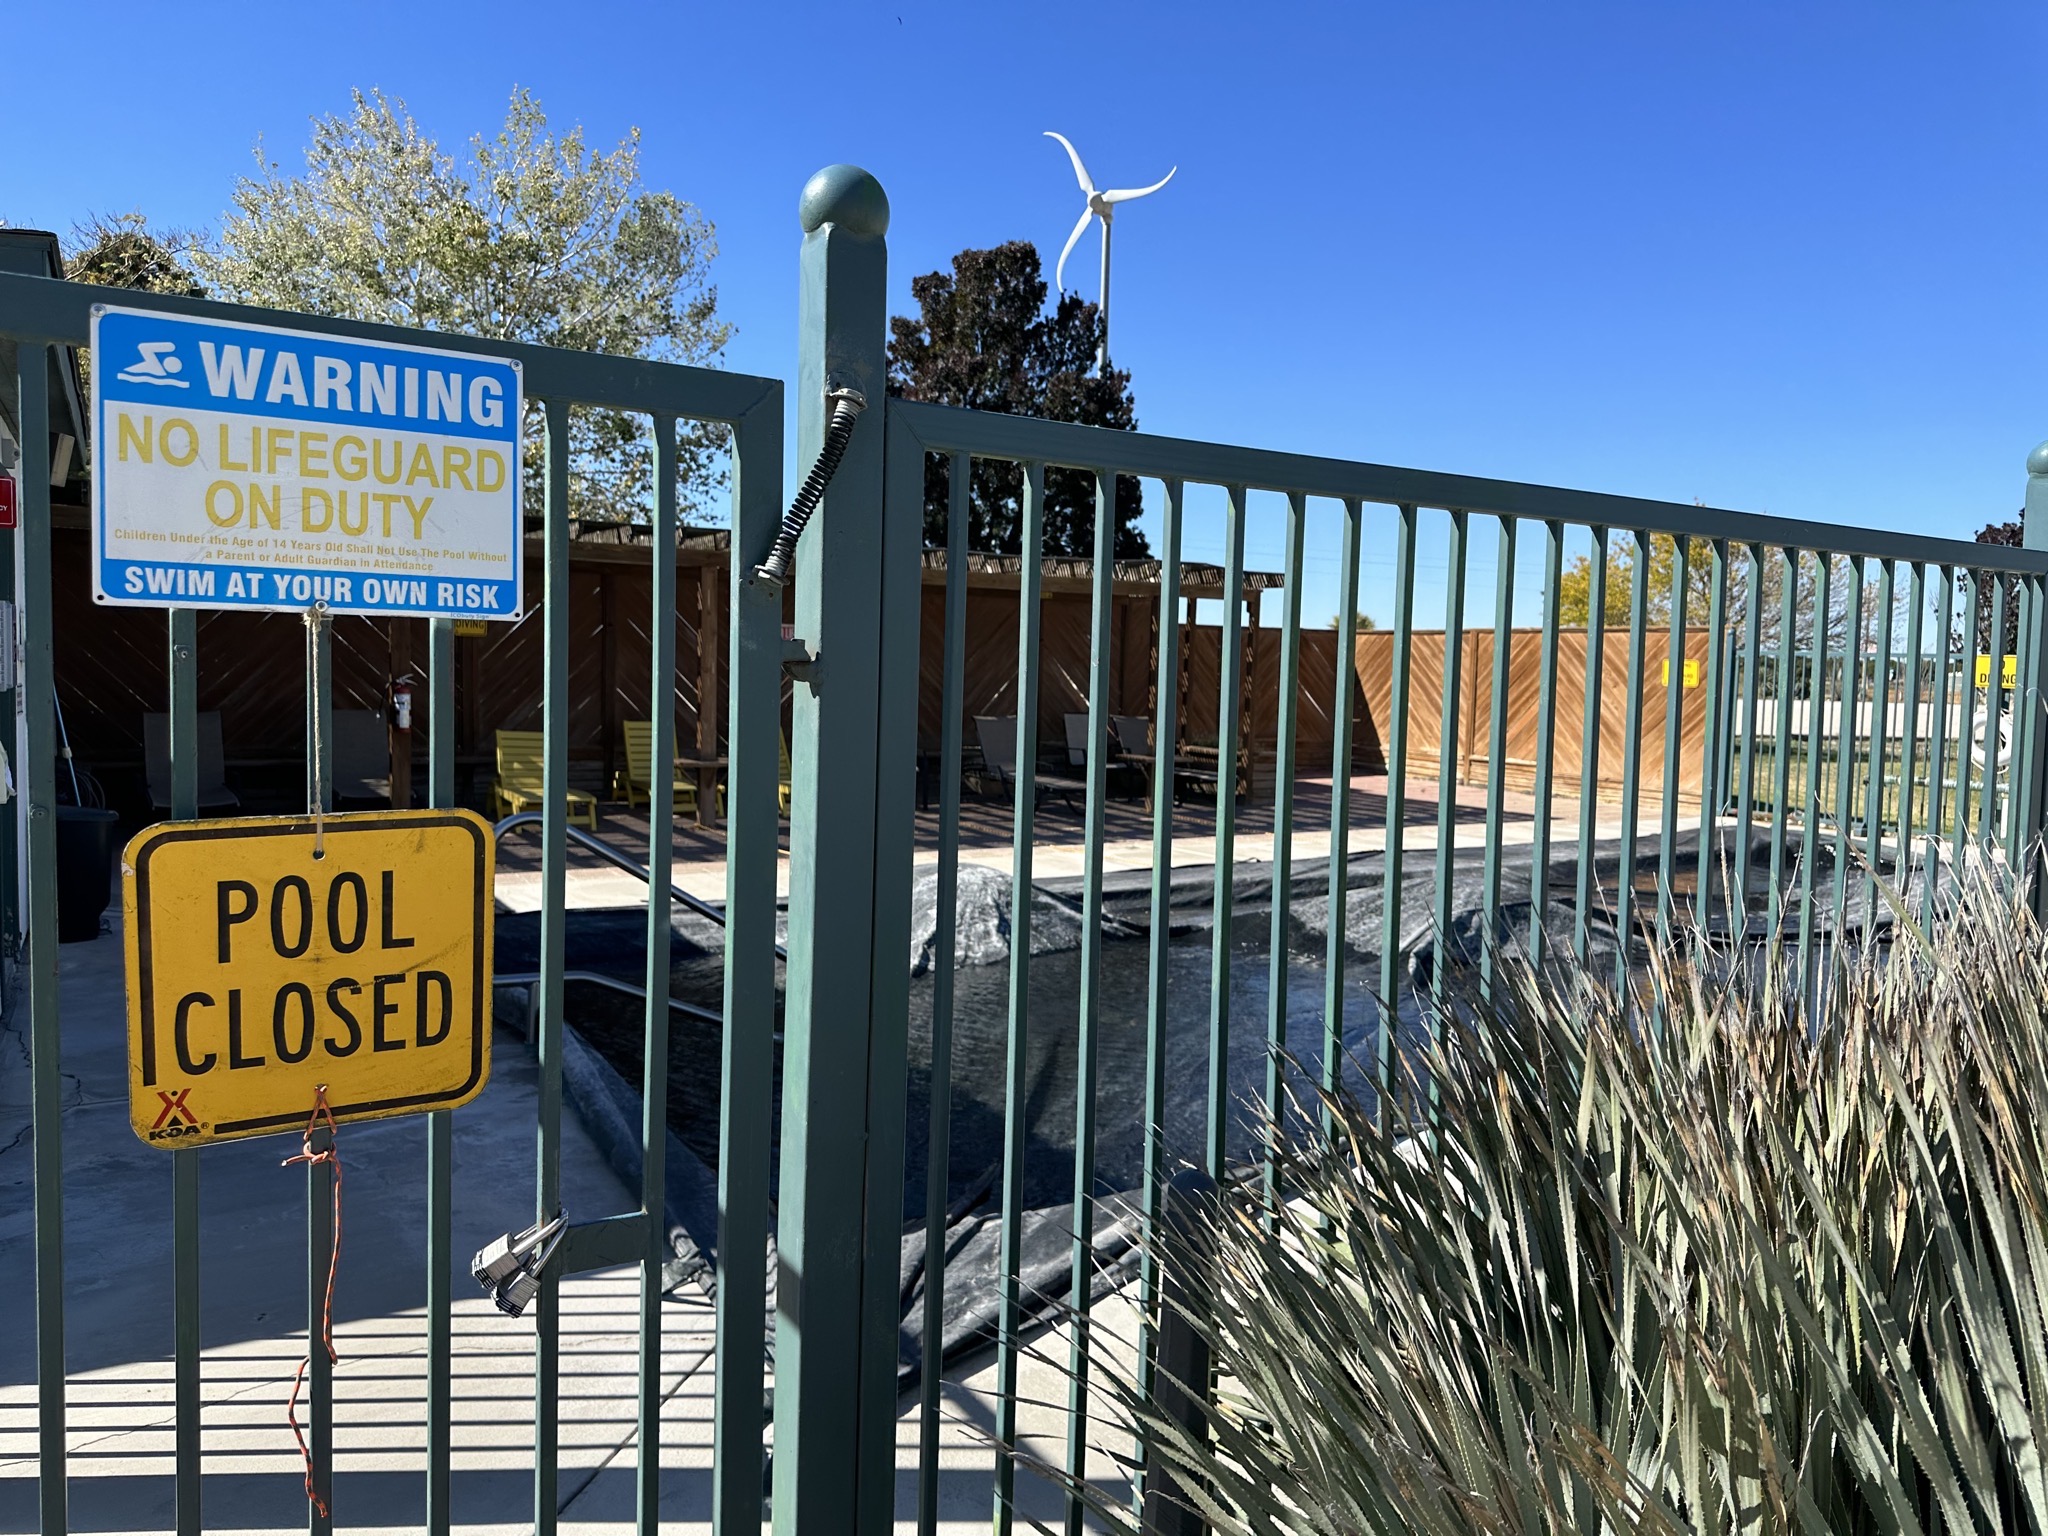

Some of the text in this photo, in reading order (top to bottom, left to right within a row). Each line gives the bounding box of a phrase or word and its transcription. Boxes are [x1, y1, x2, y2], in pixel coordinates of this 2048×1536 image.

[199, 341, 504, 427] WARNING
[118, 413, 506, 493] NO LIFEGUARD
[205, 480, 435, 540] ON DUTY
[114, 529, 507, 562] Children Under the Age of 14 Years Old Shall Not Use The Pool Without
[205, 550, 434, 571] a Parent or Adult Guardian in Attendance
[124, 566, 499, 609] SWIM AT YOUR OWN RISK
[217, 870, 415, 964] POOL
[174, 970, 453, 1076] CLOSED
[149, 1125, 201, 1141] KOA
